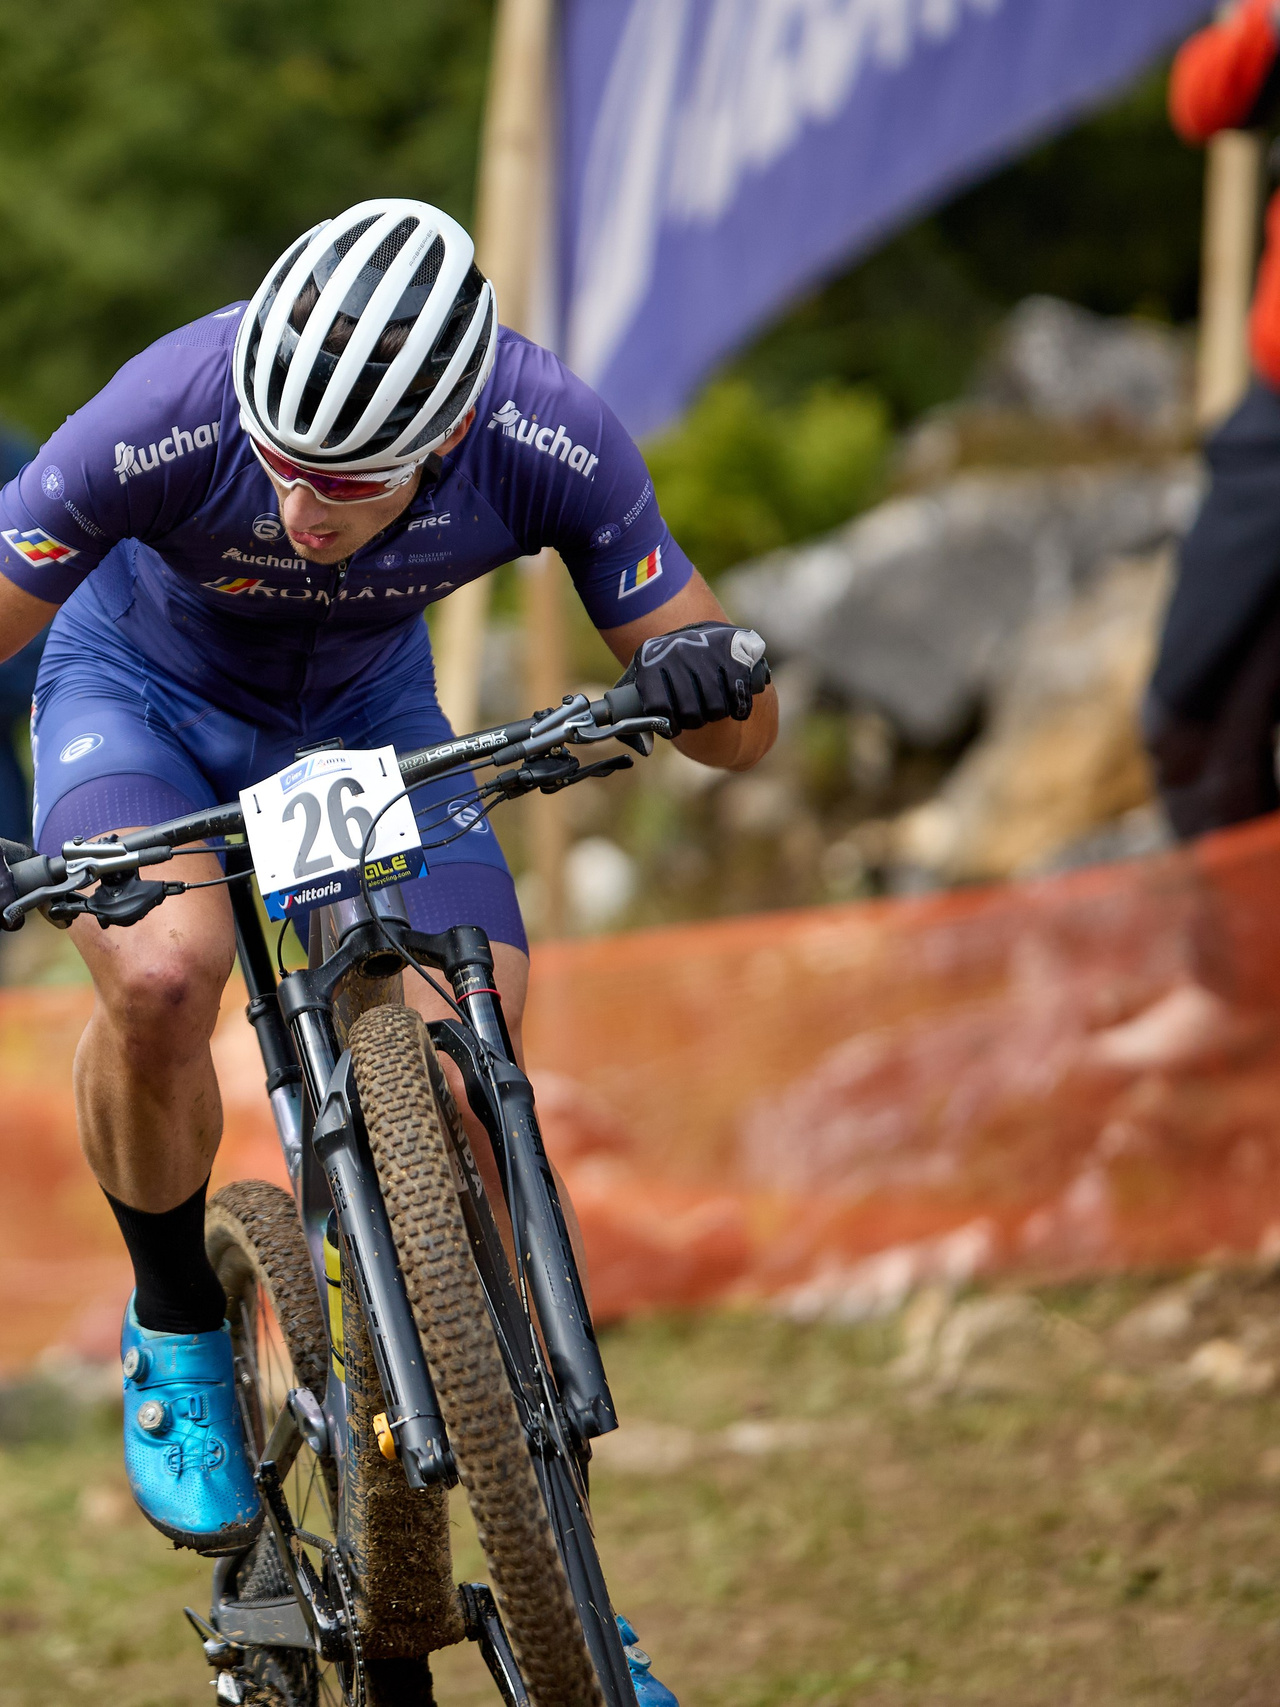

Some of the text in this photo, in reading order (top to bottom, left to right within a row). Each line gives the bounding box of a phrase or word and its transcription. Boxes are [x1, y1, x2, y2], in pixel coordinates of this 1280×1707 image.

[407, 512, 451, 532] FRC
[221, 547, 307, 571] Auchan
[281, 776, 377, 880] 26
[368, 870, 412, 888] alecycling.com
[293, 880, 342, 905] vittoria
[438, 1080, 483, 1199] KENDA
